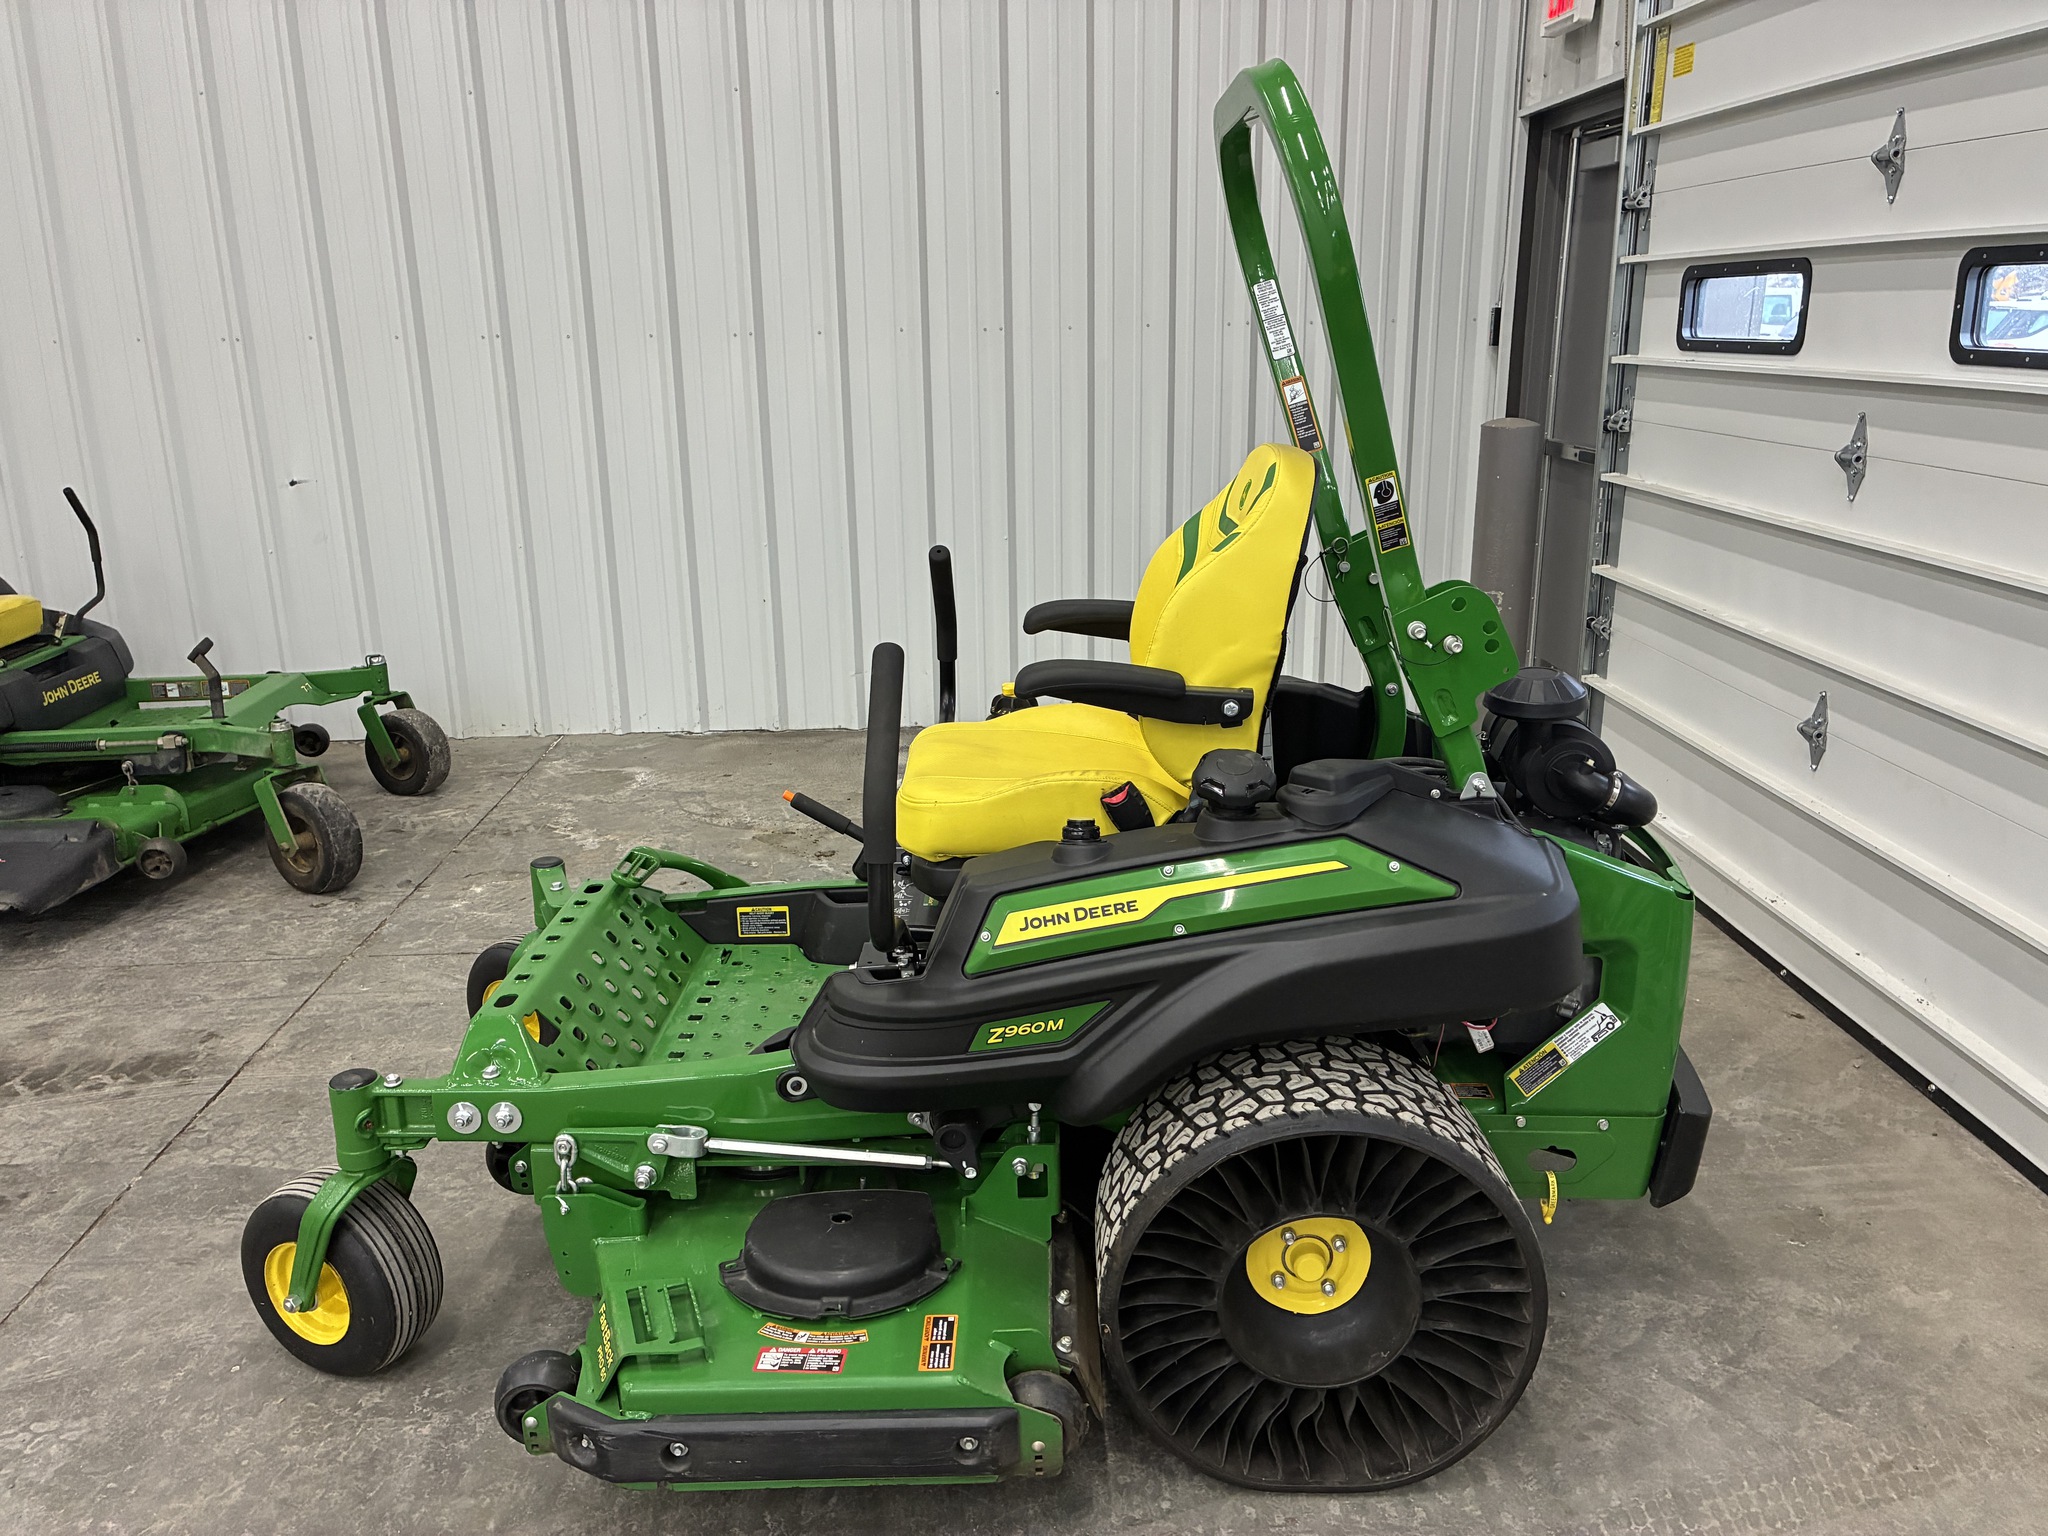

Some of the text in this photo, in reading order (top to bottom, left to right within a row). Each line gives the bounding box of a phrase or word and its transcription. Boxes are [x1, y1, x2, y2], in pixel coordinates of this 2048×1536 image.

[42, 671, 102, 706] JOHN DEERE
[1020, 900, 1138, 931] JOHN DEERE
[987, 1018, 1064, 1043] Z960M
[1523, 1049, 1548, 1070] ATENCIÓN
[599, 1303, 613, 1368] FastBack
